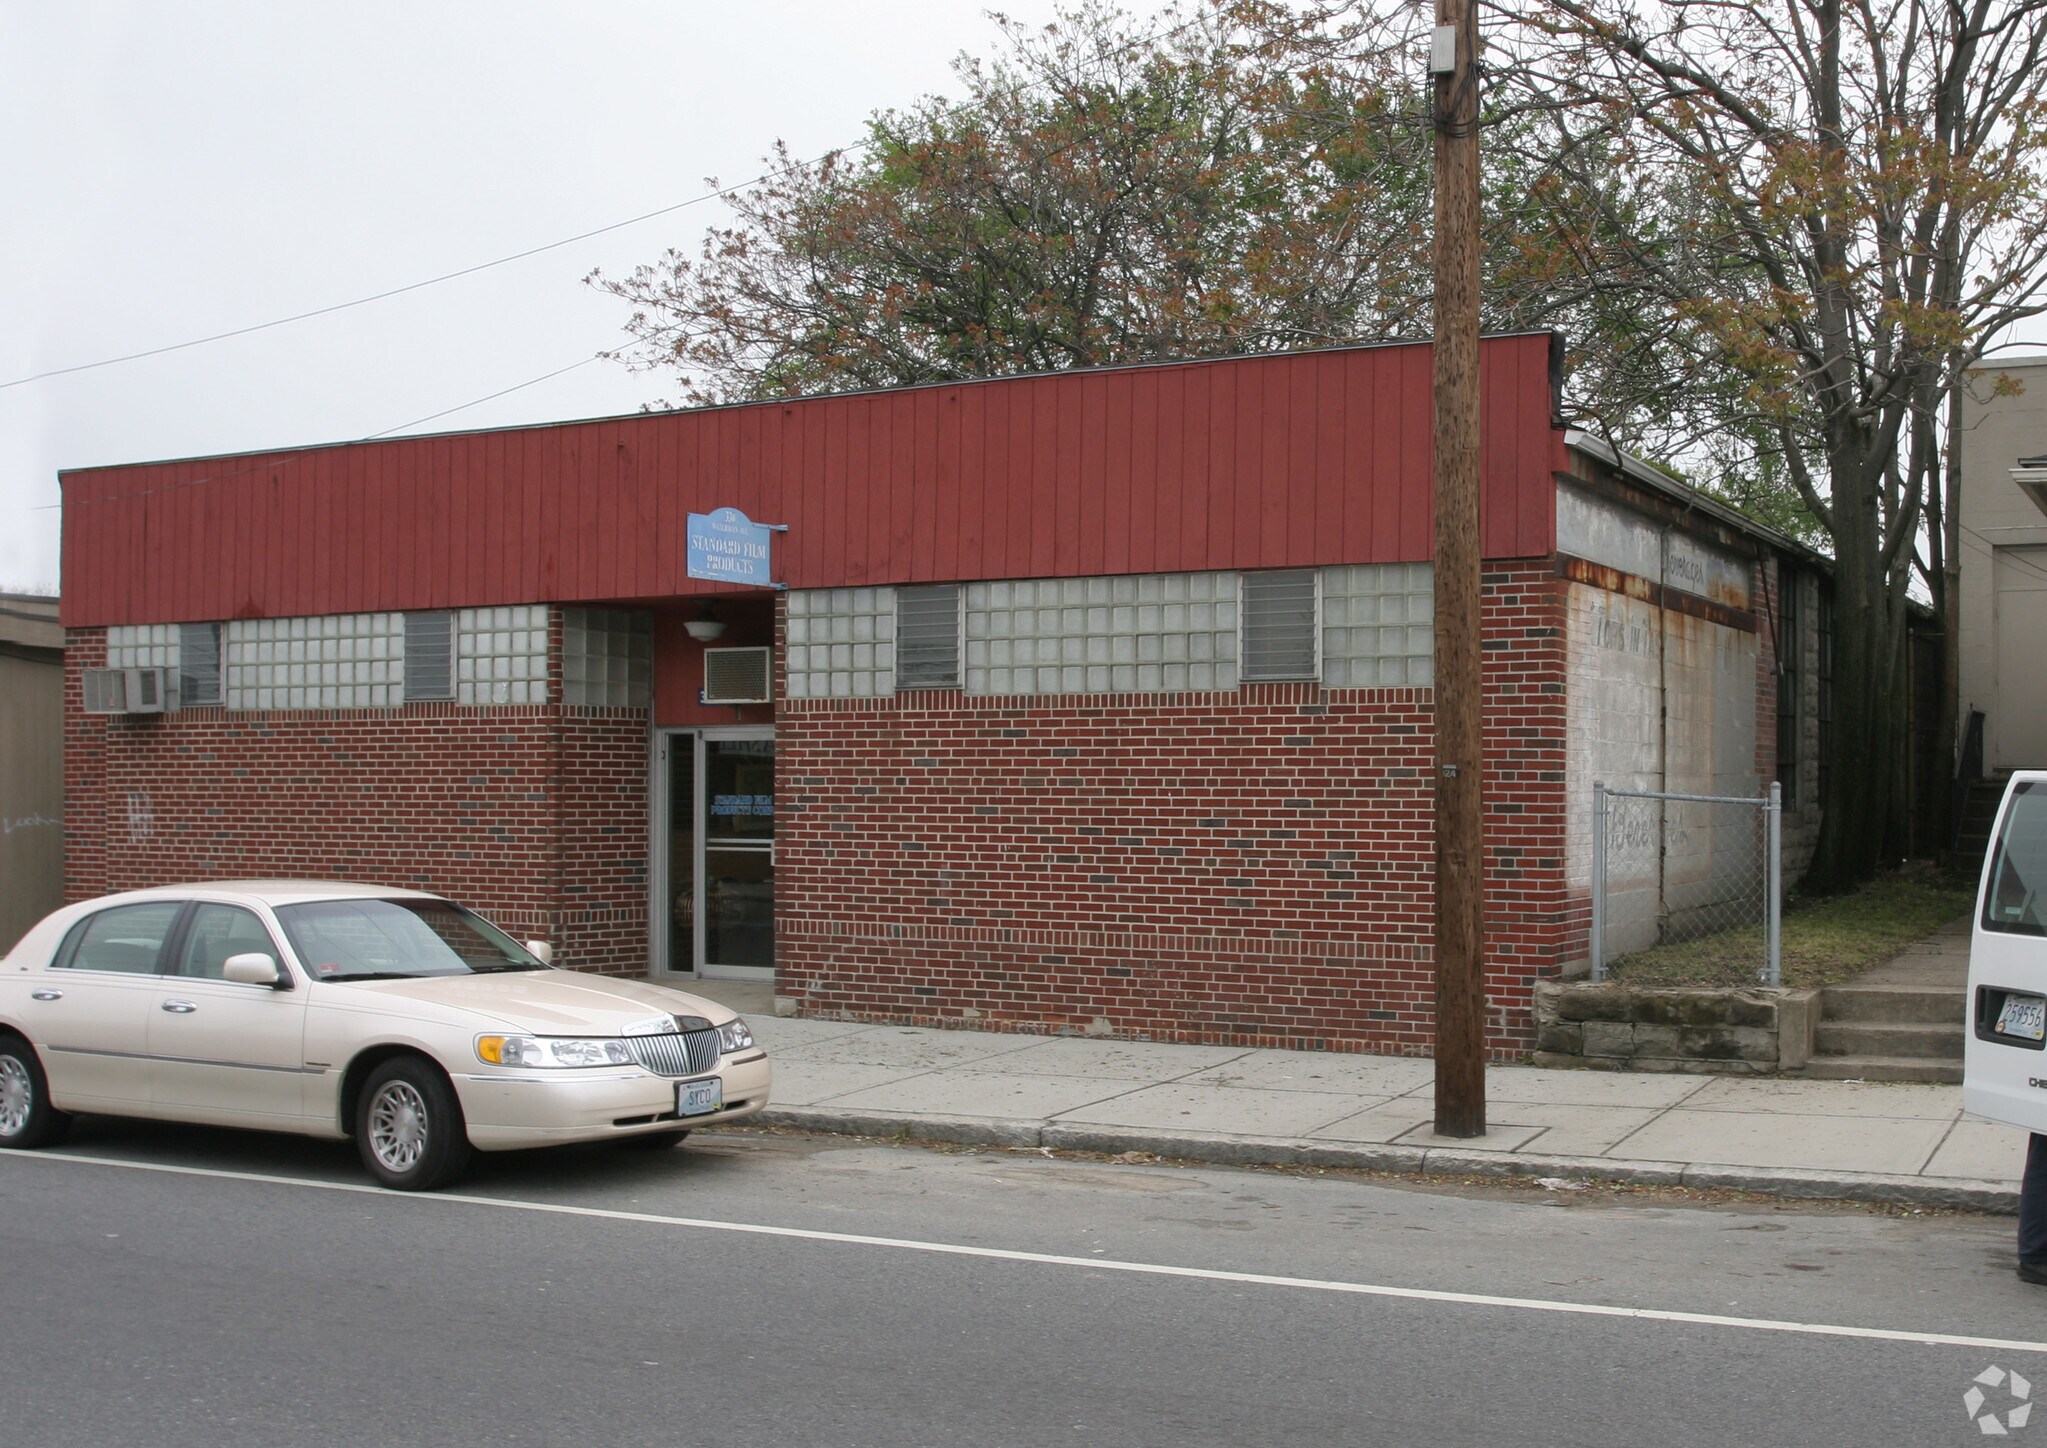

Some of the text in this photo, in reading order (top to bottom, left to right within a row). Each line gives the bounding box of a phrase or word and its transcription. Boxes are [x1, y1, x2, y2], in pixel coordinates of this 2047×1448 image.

[691, 535, 766, 559] STANDARD FILM
[706, 554, 754, 575] PRODUCTS
[2002, 1003, 2043, 1028] 259556
[689, 1088, 711, 1106] SYCO
